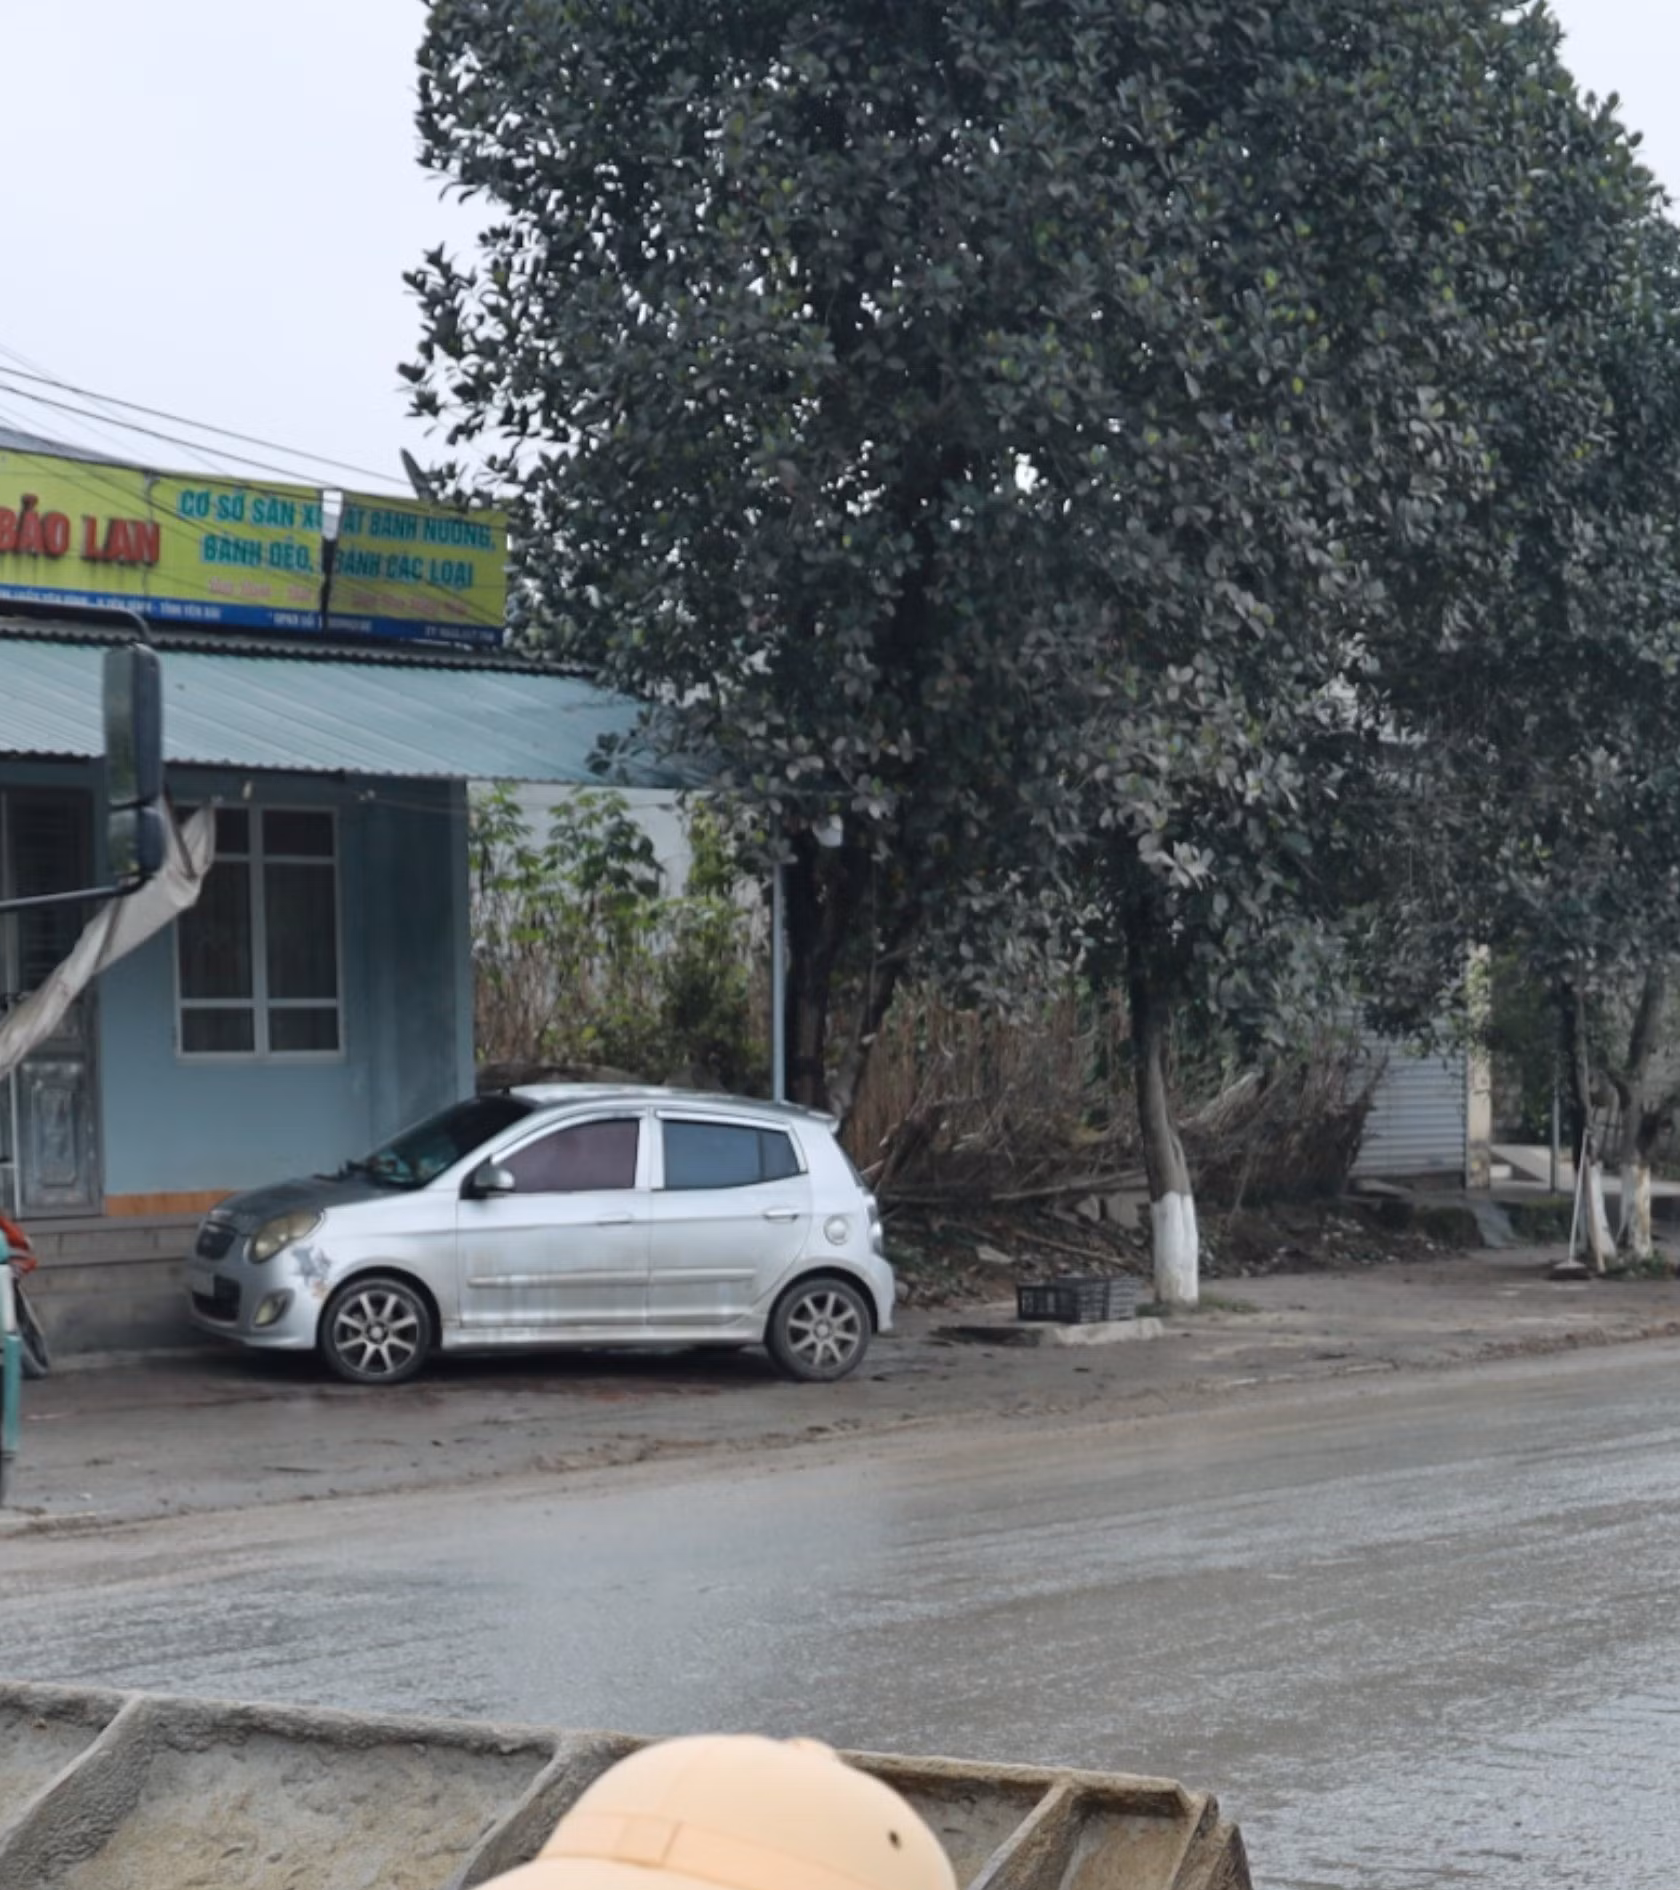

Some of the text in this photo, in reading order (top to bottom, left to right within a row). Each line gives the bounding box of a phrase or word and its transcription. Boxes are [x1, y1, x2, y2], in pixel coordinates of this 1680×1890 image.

[180, 488, 211, 519] CƠ
[216, 485, 245, 522] SỞ
[81, 515, 160, 566] LAN
